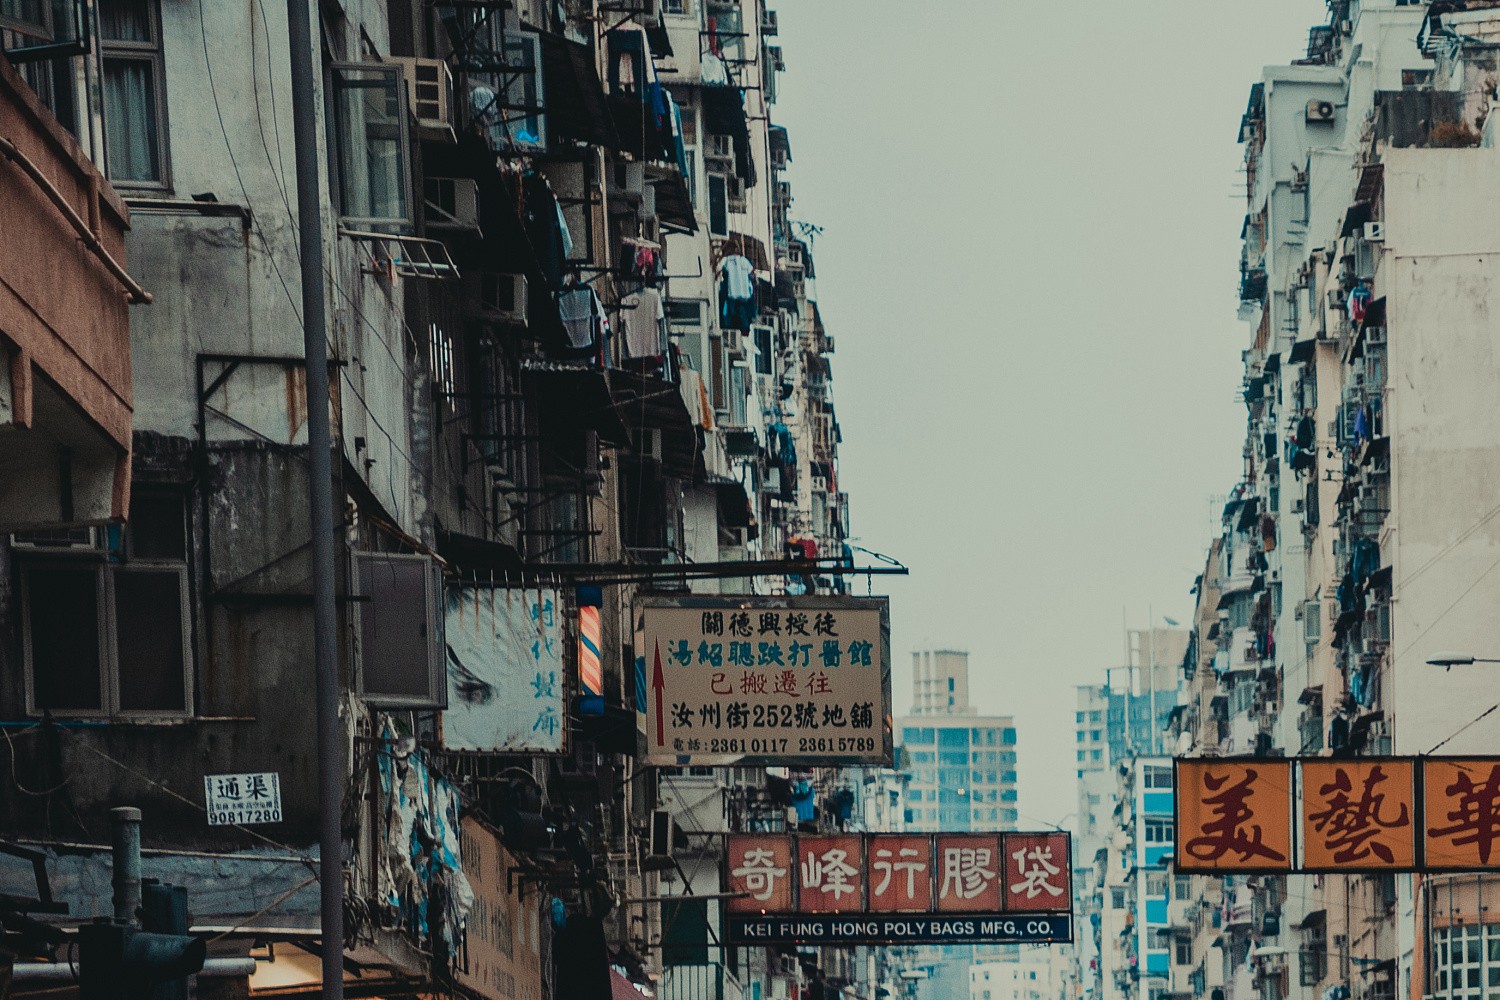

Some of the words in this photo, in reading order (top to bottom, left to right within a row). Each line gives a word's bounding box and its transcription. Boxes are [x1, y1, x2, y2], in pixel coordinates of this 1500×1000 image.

[702, 610, 839, 637] 關德興授徒
[710, 670, 833, 698] 已搬遷往
[799, 736, 875, 752] 23615789
[217, 774, 269, 800] 通渠
[209, 810, 280, 824] 90817280
[732, 846, 1064, 900] 奇峰行膠袋
[744, 924, 772, 936] KEI
[780, 924, 824, 937] FUNG
[831, 923, 878, 936] HONG
[884, 922, 925, 936] POLY
[930, 922, 975, 936] BAGS
[1026, 922, 1054, 935] CO.
